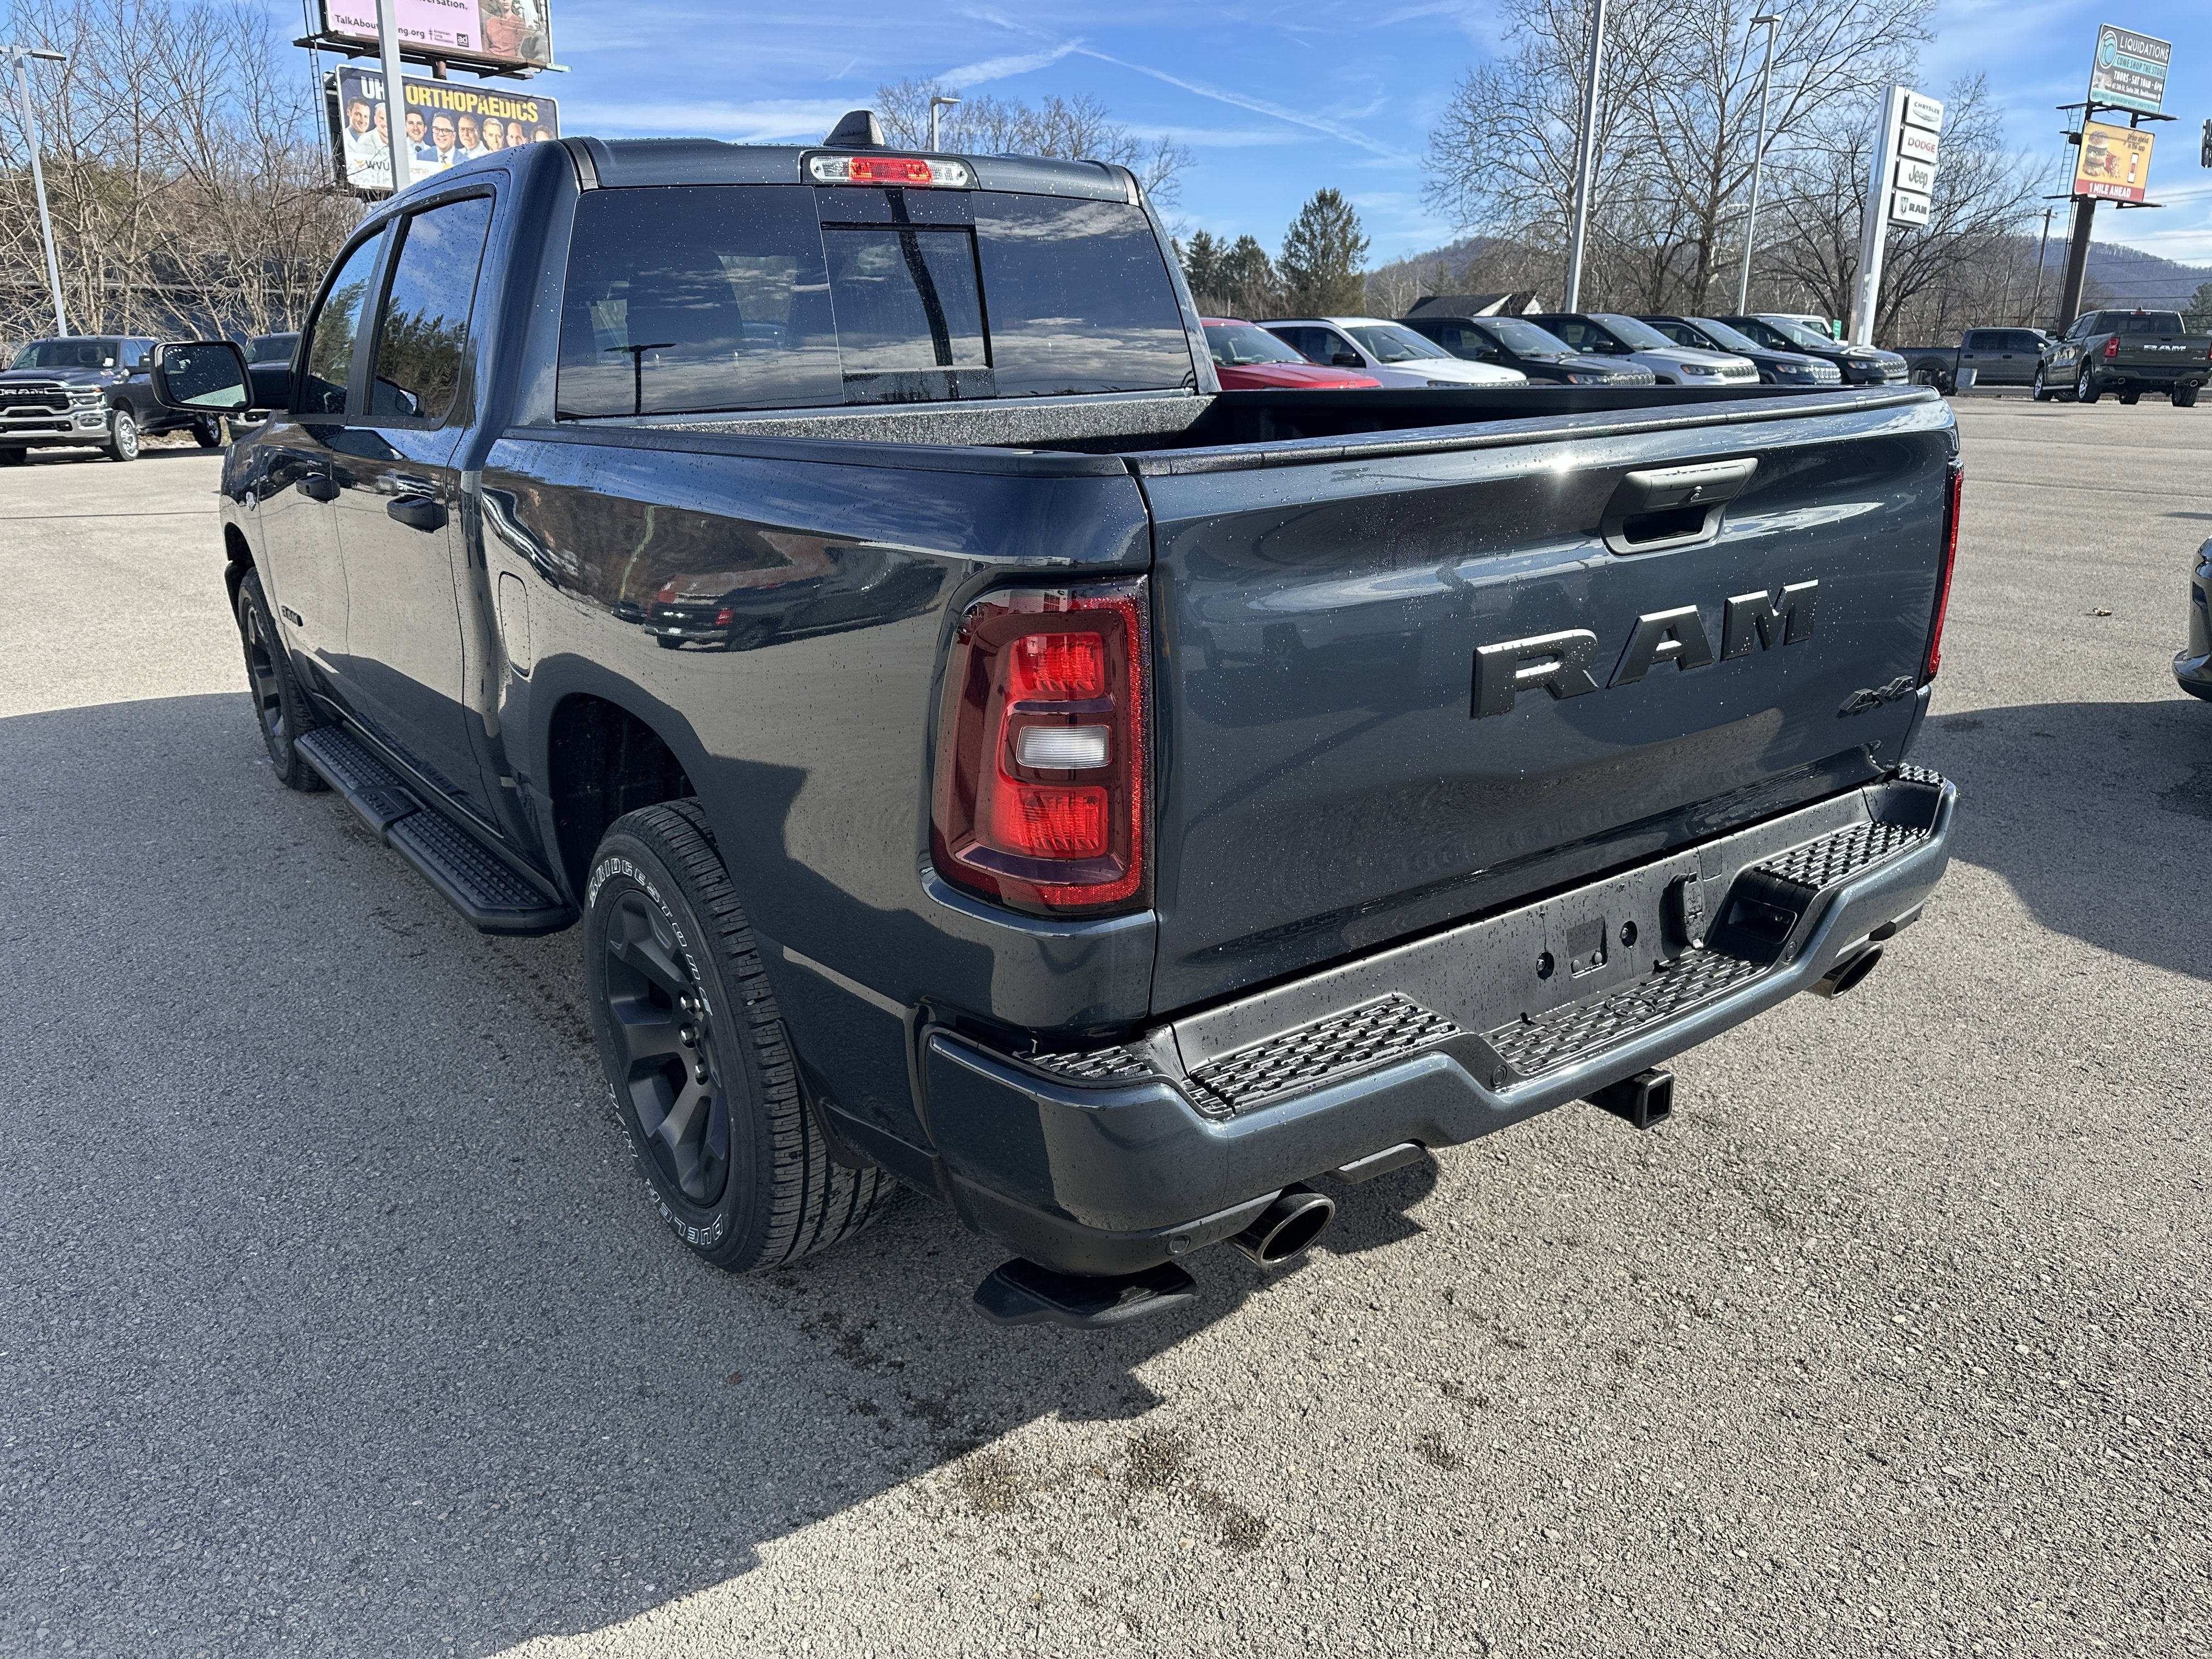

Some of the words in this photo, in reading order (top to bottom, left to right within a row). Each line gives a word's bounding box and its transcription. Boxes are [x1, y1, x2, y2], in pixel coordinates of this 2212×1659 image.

[2119, 36, 2169, 60] LIQUIDATIONS
[2117, 57, 2129, 67] COME
[2130, 60, 2142, 71] SHOP
[2143, 63, 2151, 74] THE
[2114, 70, 2129, 83] THURS
[2131, 75, 2140, 85] SAT
[360, 76, 385, 100] UH
[406, 83, 539, 123] ORTHOPAEDICS
[1914, 101, 1940, 114] CHRYSLER
[1908, 137, 1936, 154] DODGE
[365, 160, 390, 171] WVU
[1909, 165, 1928, 189] Jeep
[2089, 183, 2093, 193] 1
[2094, 183, 2109, 195] MILE
[2109, 185, 2131, 198] AHEAD
[1909, 204, 1927, 215] RAM
[1470, 579, 1819, 720] RAM
[589, 858, 713, 1016] BRIDGESTONE
[645, 1178, 723, 1245] DUELER
